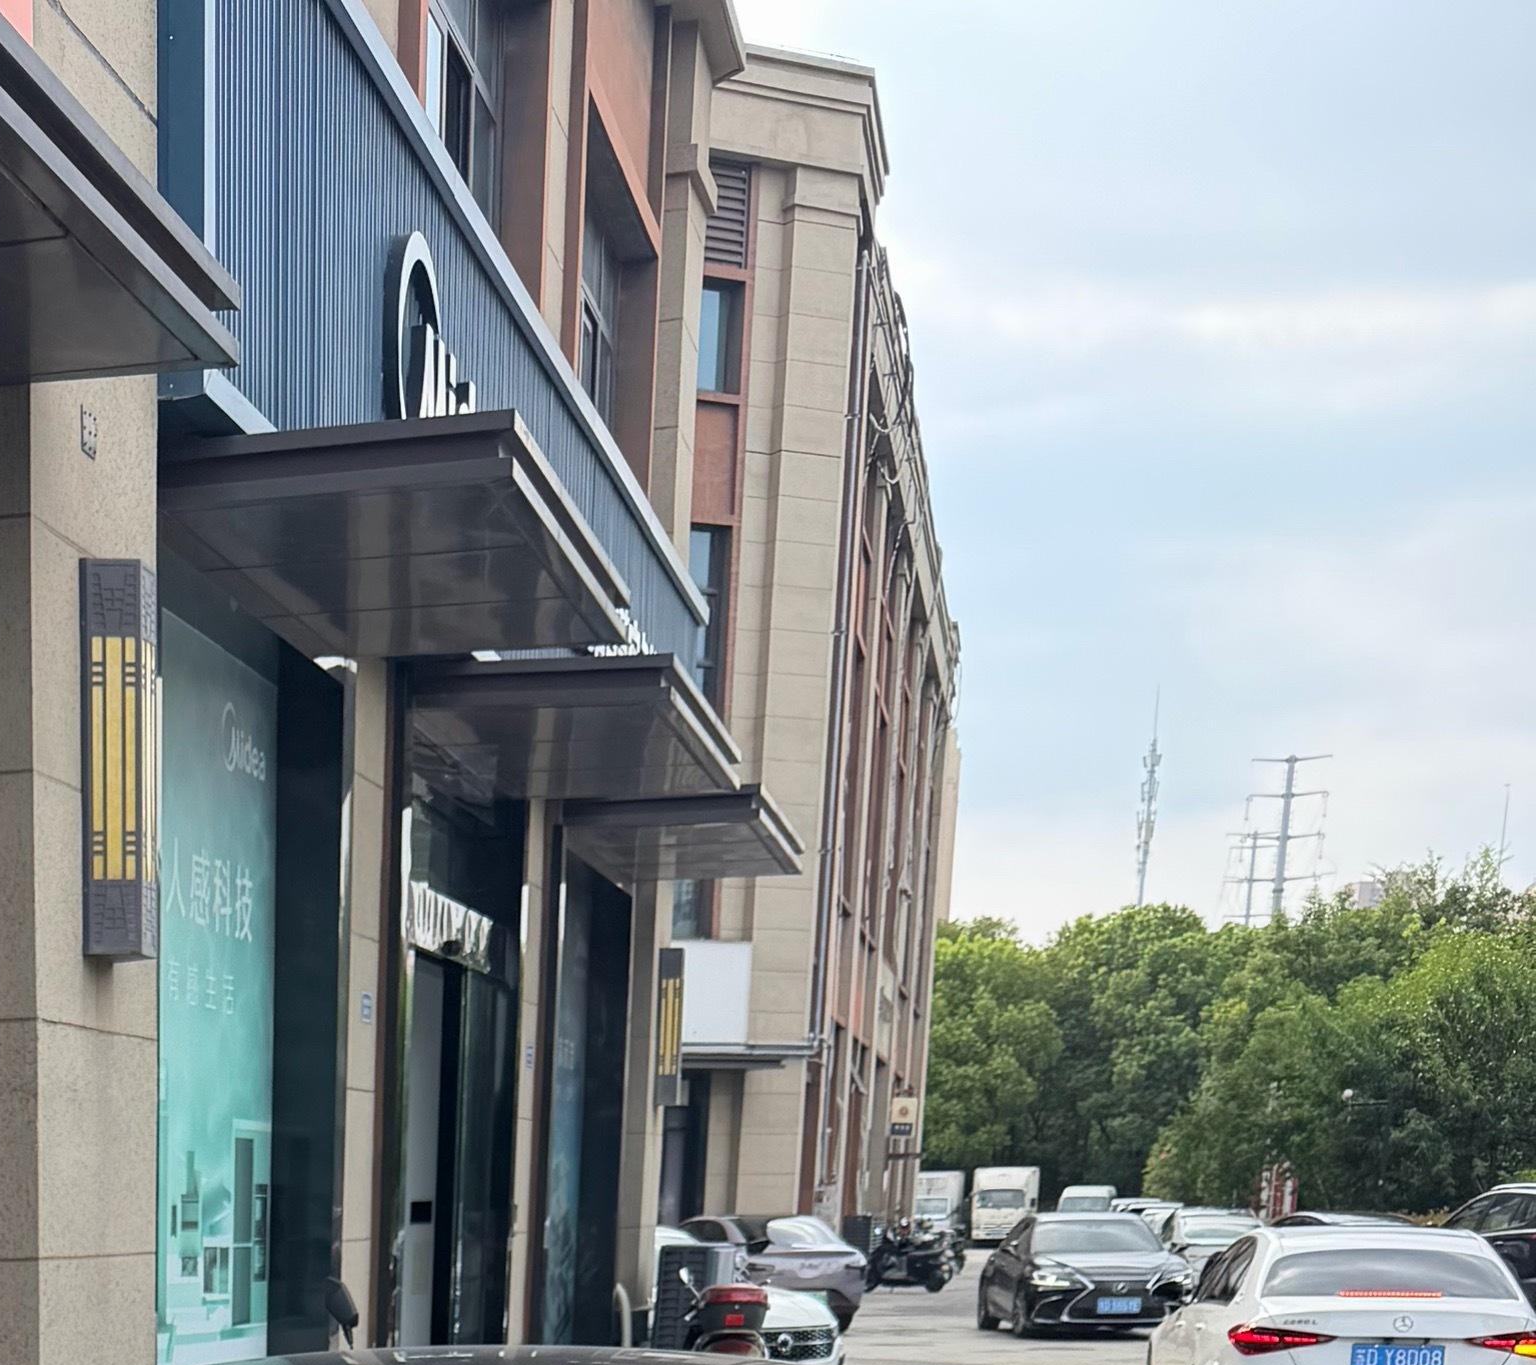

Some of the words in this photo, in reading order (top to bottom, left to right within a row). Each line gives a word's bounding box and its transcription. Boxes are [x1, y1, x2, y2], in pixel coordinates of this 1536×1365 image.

[222, 701, 267, 782] Midea
[165, 836, 253, 943] 人感科技
